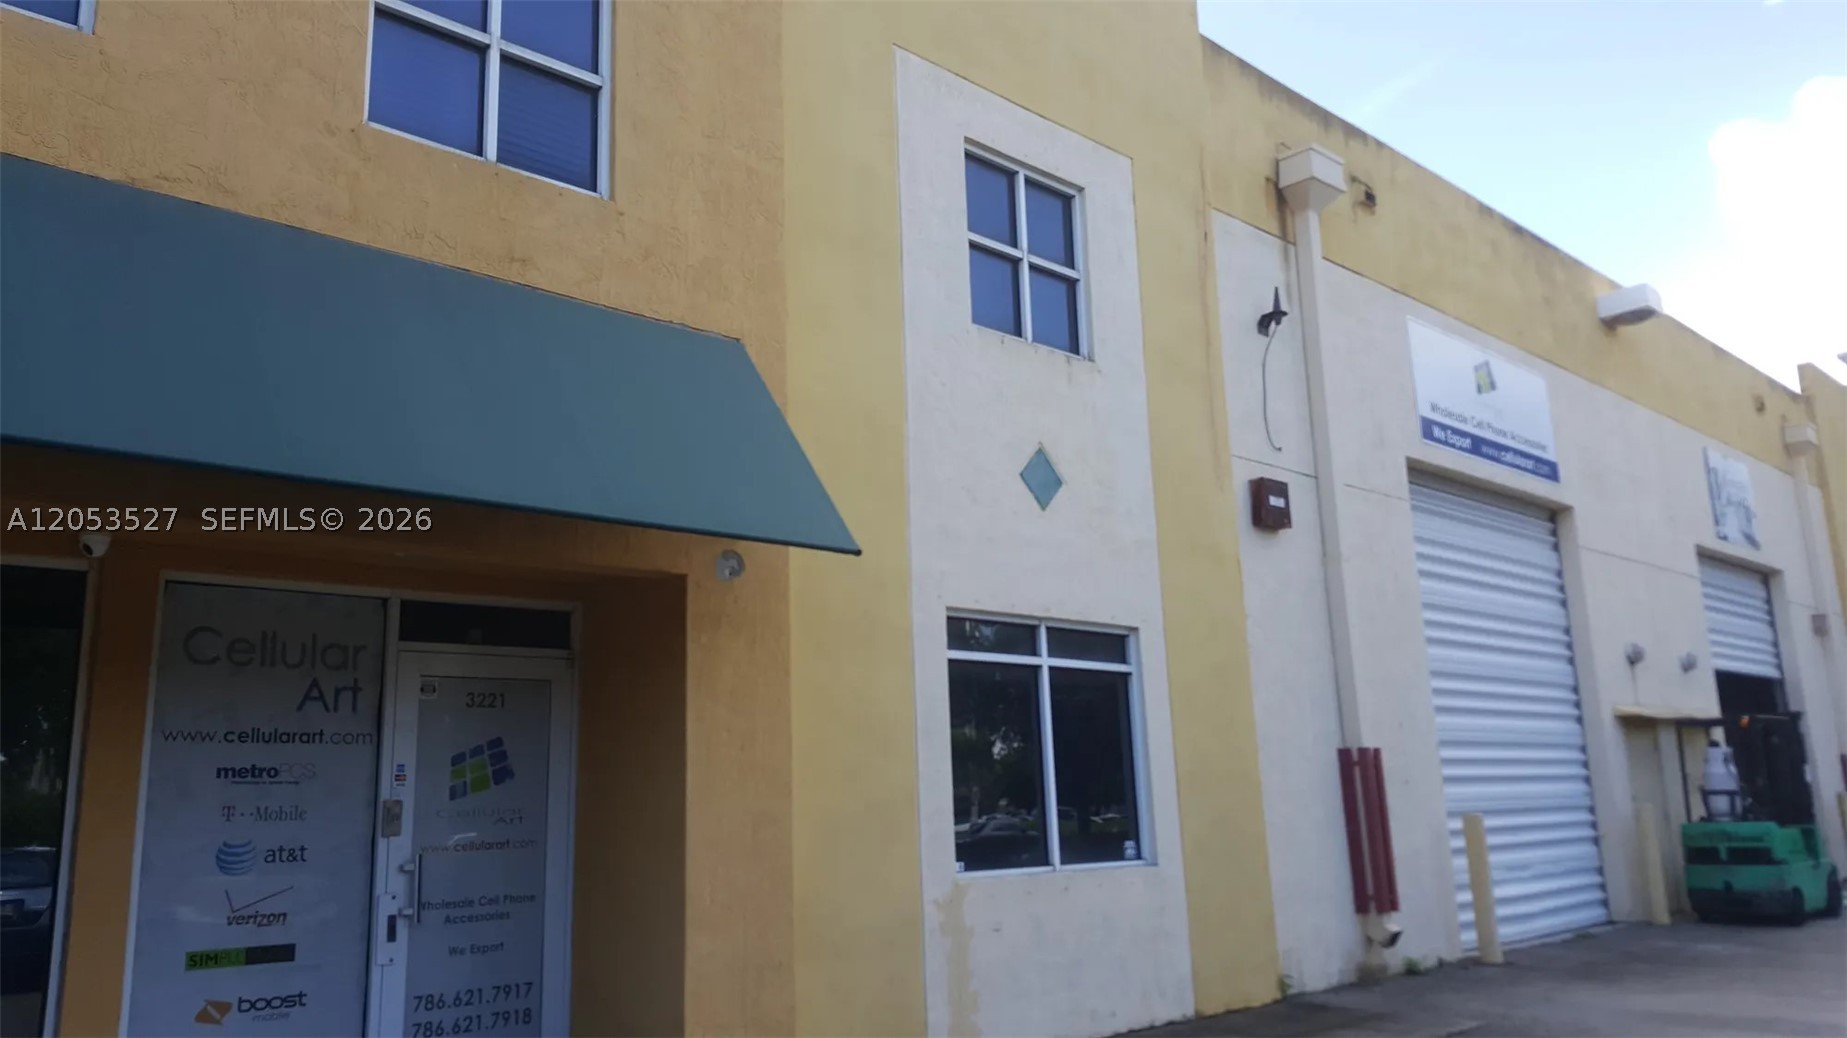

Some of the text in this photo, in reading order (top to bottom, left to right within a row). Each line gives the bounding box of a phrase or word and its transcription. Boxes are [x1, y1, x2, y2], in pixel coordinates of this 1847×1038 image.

[182, 625, 367, 672] Cellular
[295, 677, 363, 714] Art
[465, 692, 505, 709] 3221
[161, 727, 373, 745] www.cellularart.com
[215, 762, 317, 780] metroPCS
[264, 845, 308, 864] at&t
[478, 894, 499, 907] Cell
[503, 893, 536, 906] Phone
[226, 910, 288, 928] verizon
[443, 910, 510, 925] Accessories
[448, 941, 504, 957] We Export
[237, 990, 308, 1014] boost
[412, 981, 534, 1014] 786.621.7917
[411, 1007, 532, 1038] 786.621.7918
